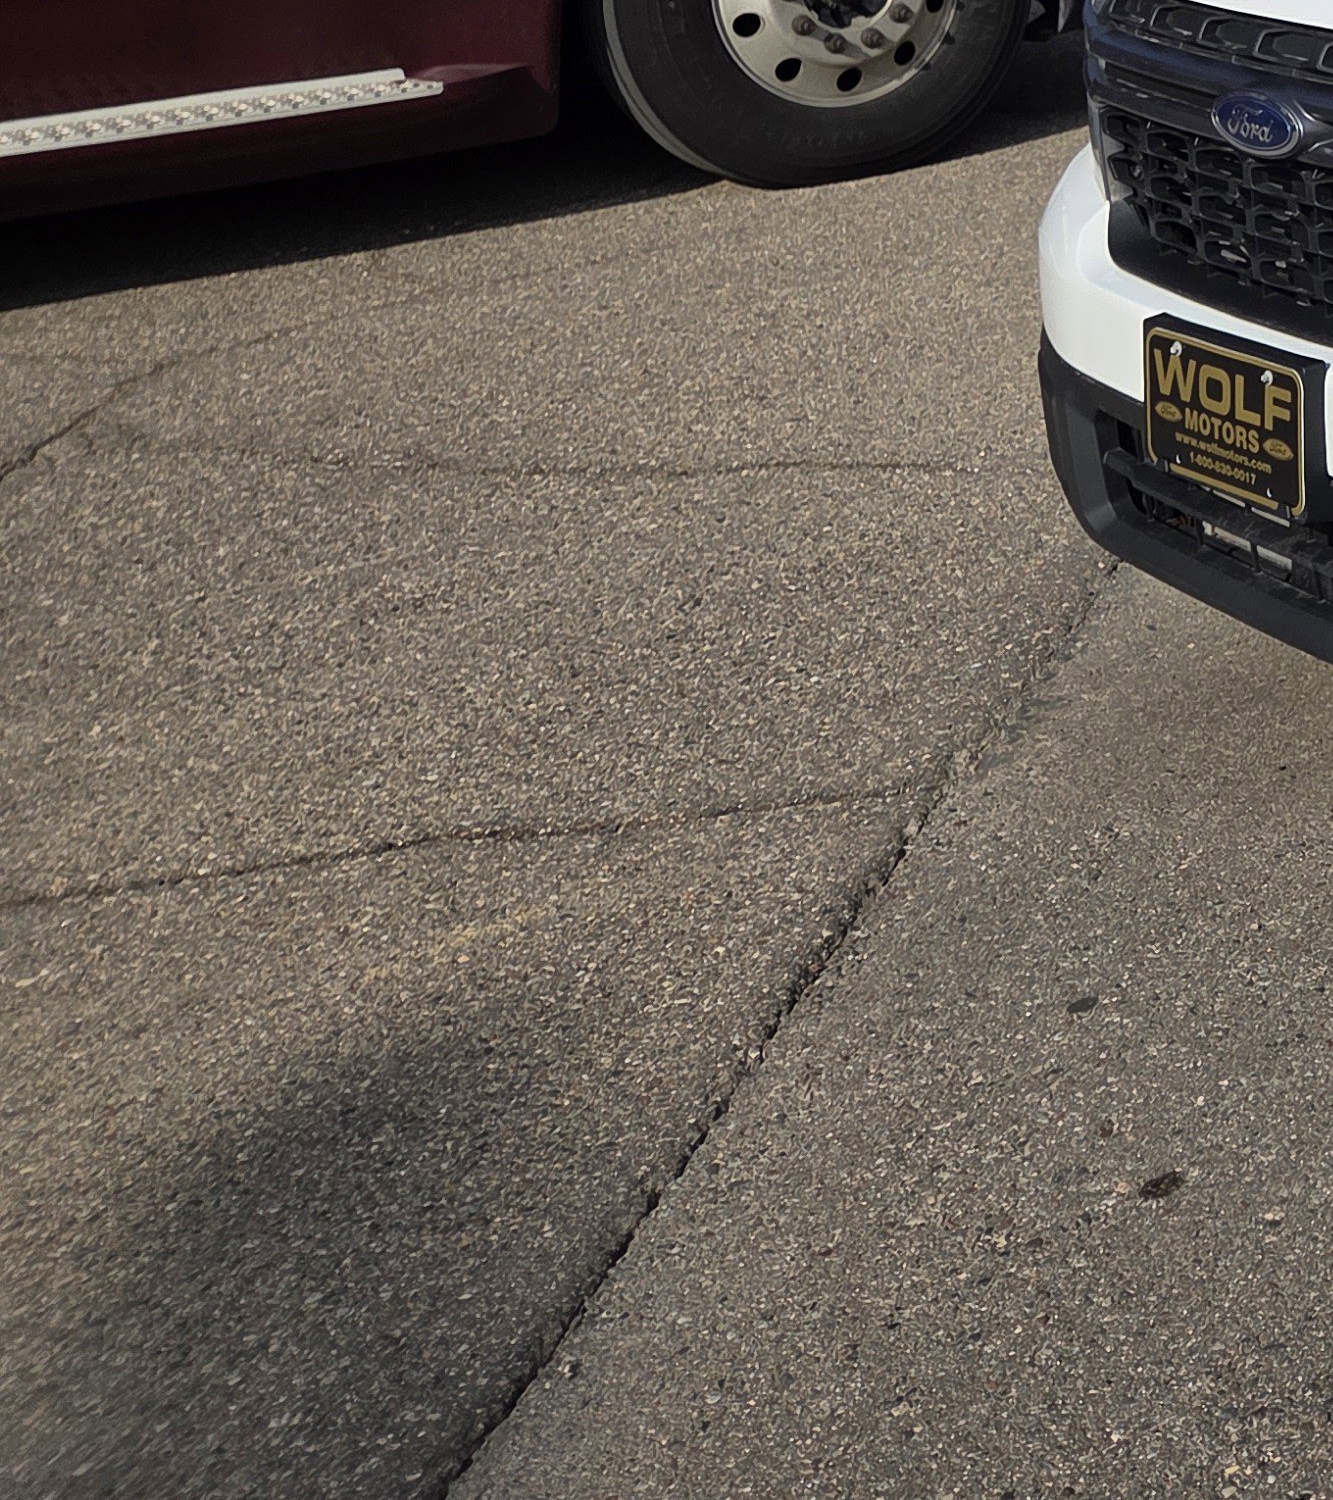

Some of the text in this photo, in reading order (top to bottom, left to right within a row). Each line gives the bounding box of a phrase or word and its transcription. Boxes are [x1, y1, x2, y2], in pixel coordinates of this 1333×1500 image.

[1227, 103, 1275, 144] Ford
[1153, 348, 1292, 432] WOLF
[1184, 407, 1260, 454] MOTORS
